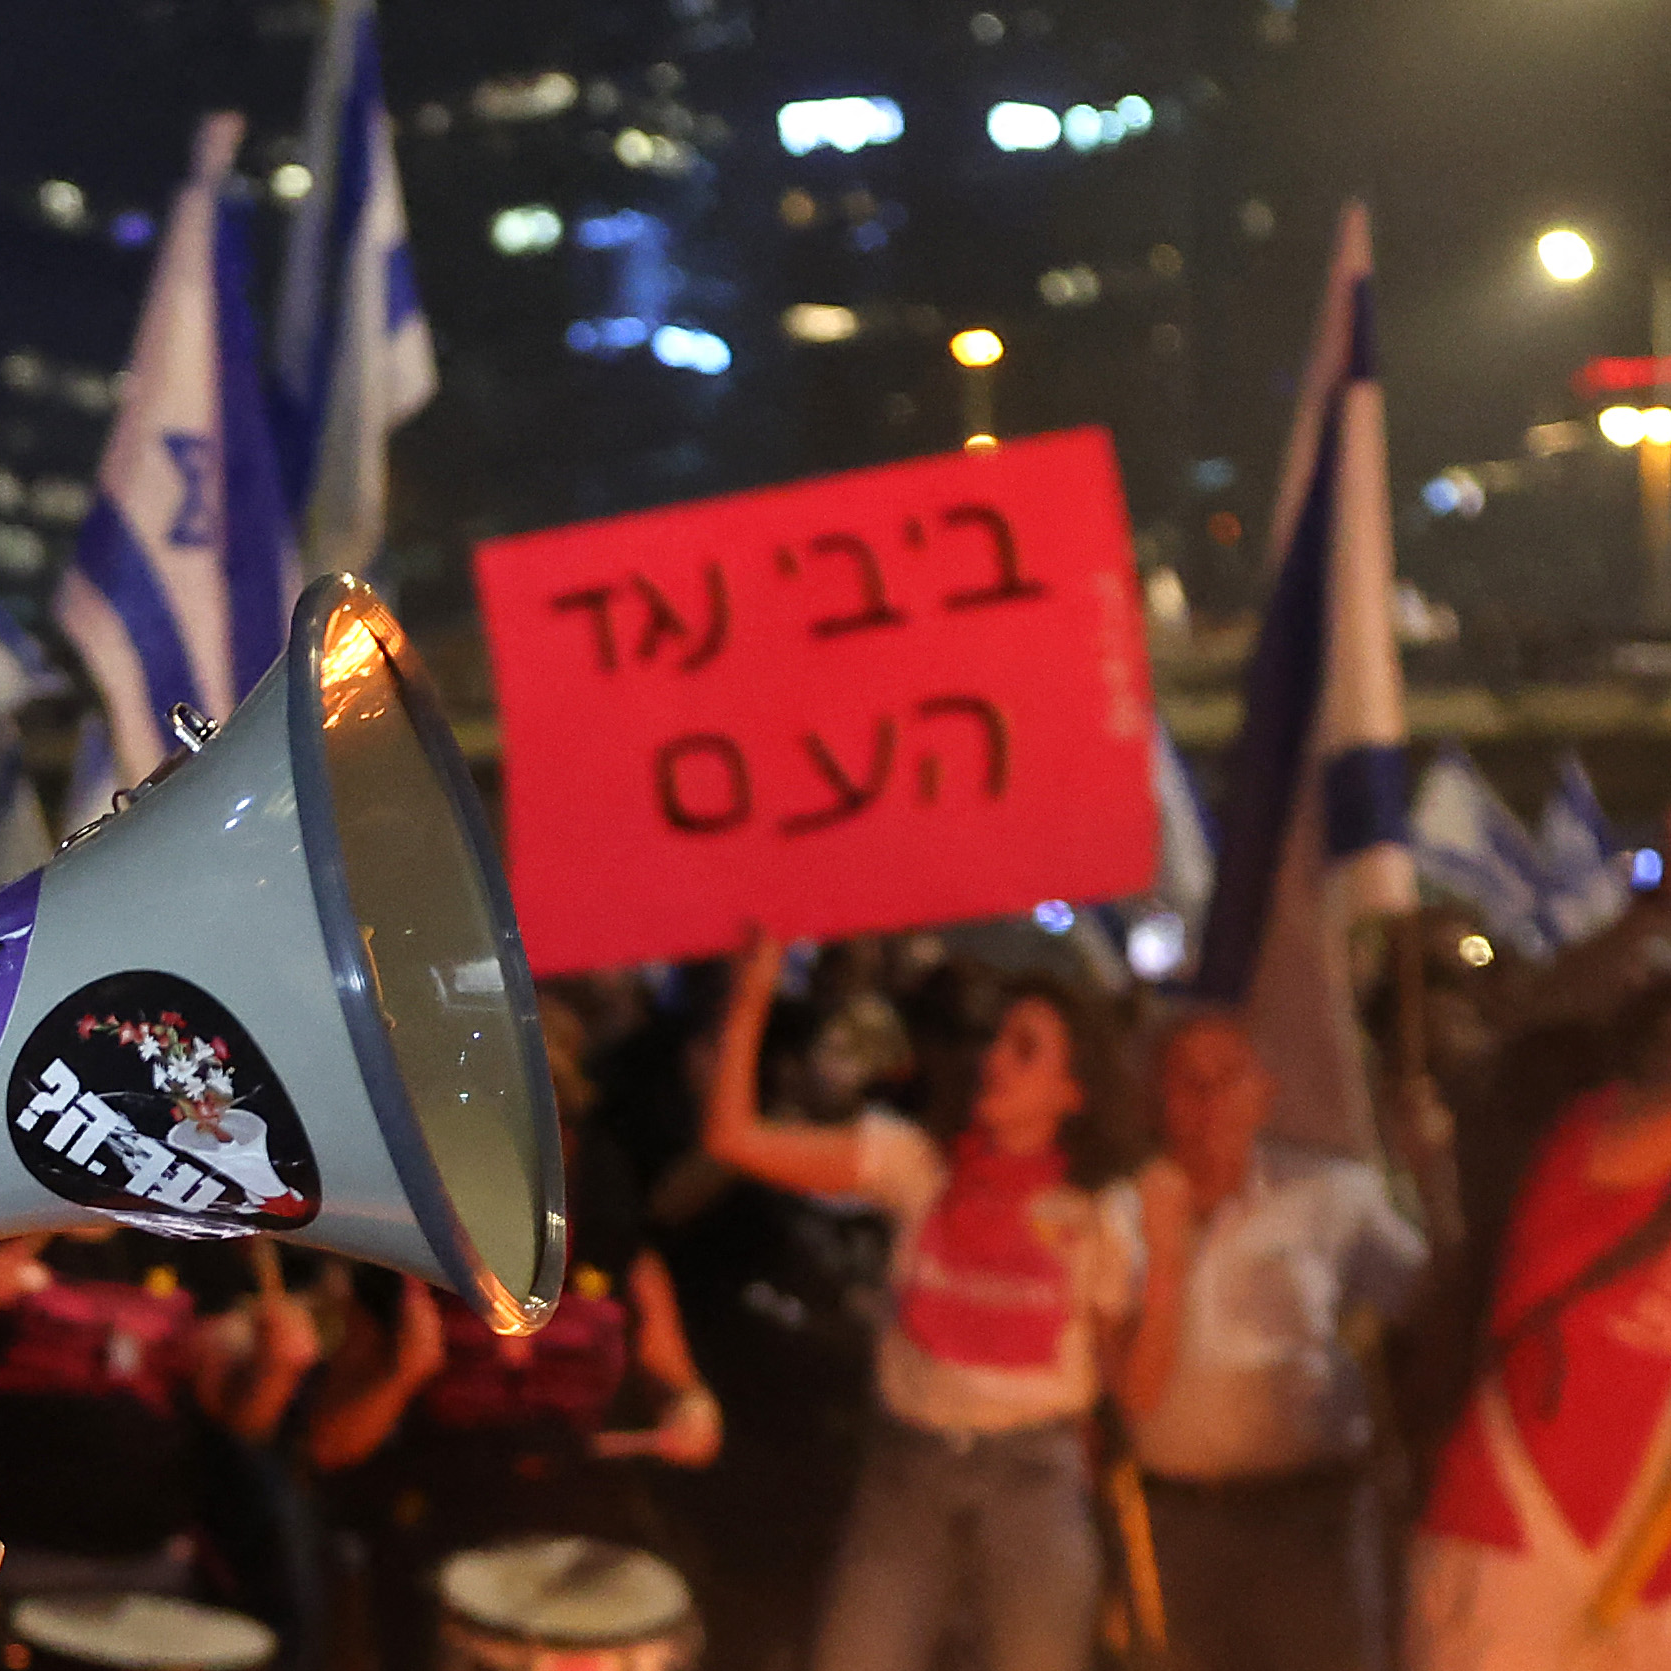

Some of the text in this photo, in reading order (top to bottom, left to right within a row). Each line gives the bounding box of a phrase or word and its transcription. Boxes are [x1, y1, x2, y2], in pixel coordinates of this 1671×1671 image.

[549, 502, 1047, 676] ביבי נגד
[656, 694, 1010, 838] העם
